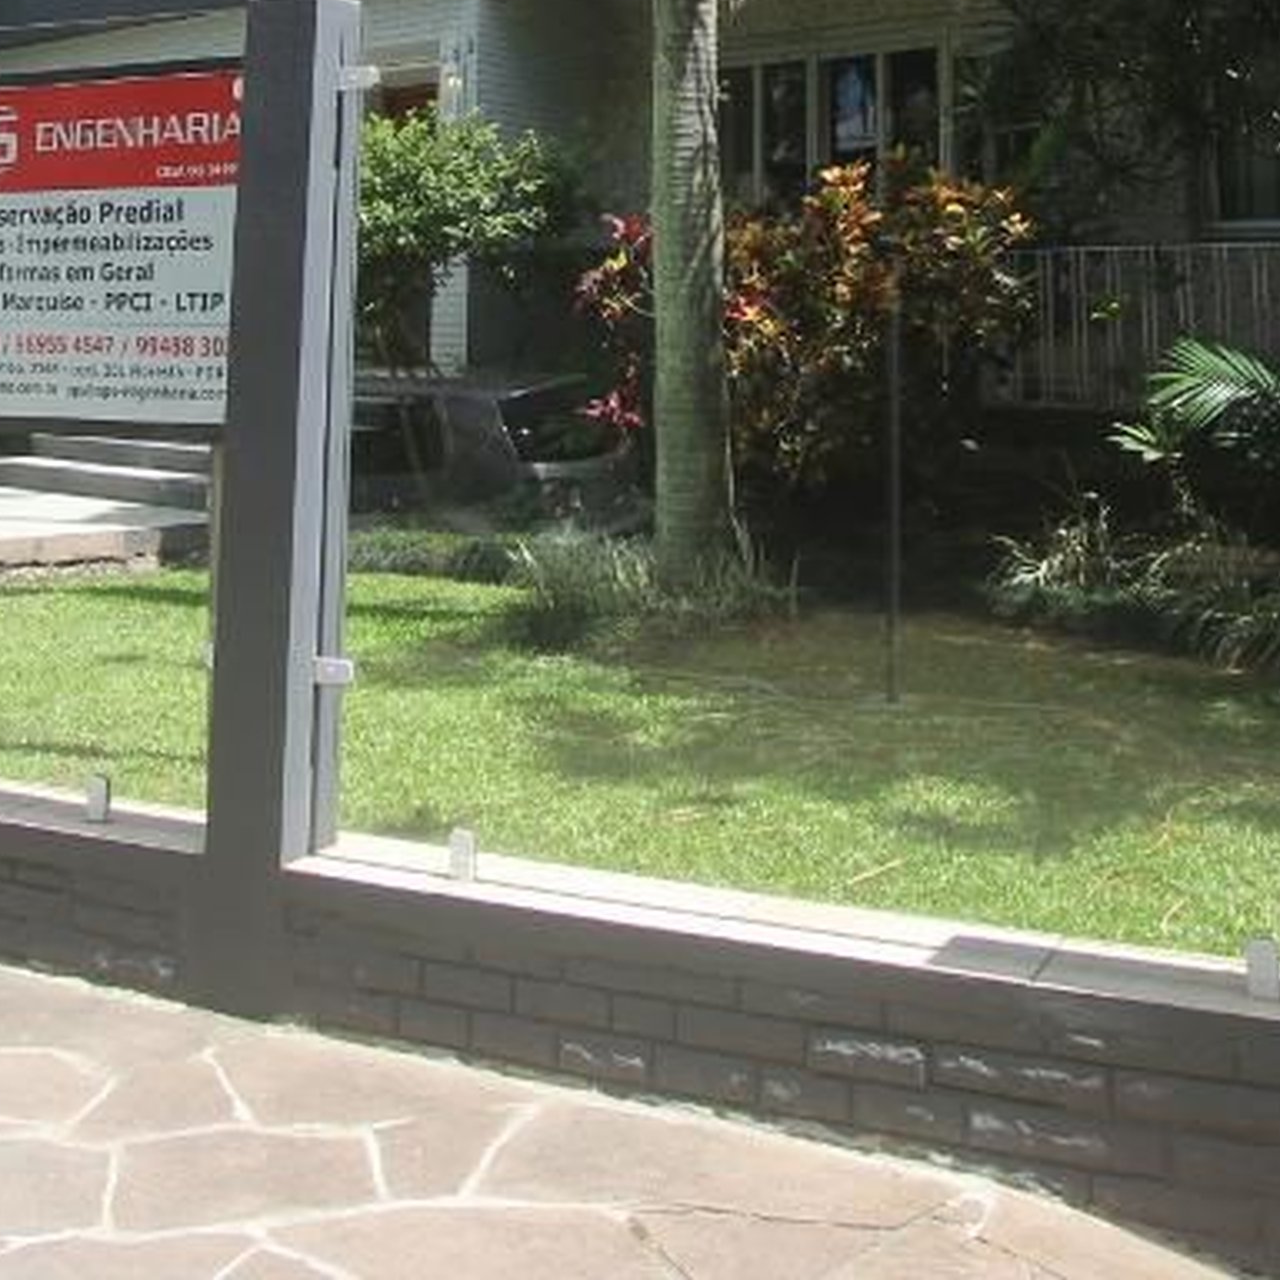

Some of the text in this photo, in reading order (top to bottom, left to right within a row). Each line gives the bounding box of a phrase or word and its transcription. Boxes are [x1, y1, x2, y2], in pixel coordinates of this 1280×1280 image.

[35, 111, 241, 152] ENGENHARIA
[99, 197, 184, 224] Predial
[66, 266, 94, 282] em
[100, 262, 154, 282] Geral
[106, 292, 152, 312] PPCI
[176, 292, 224, 312] LTIP
[200, 335, 229, 358] 30
